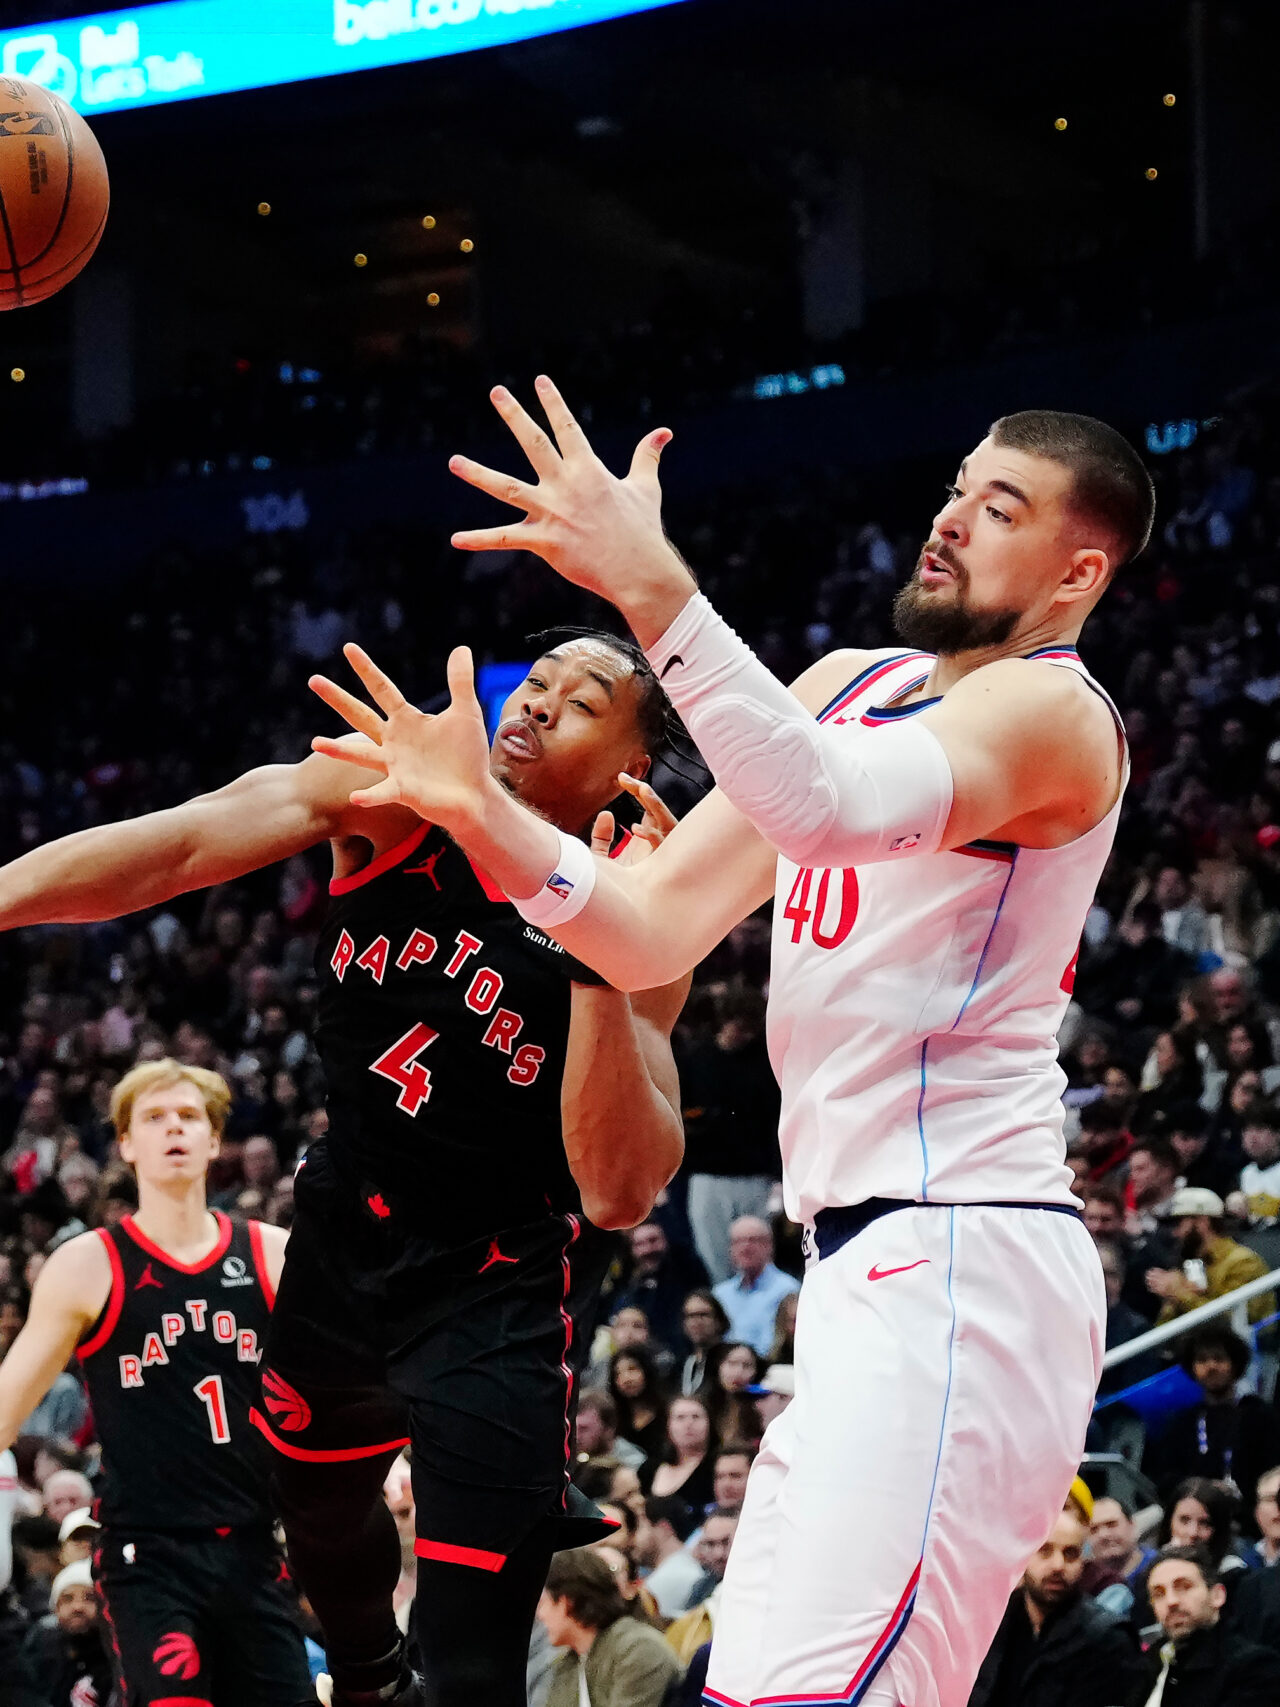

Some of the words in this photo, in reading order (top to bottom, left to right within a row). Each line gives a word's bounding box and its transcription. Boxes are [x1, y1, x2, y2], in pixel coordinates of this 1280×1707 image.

[523, 926, 547, 946] Sun
[783, 866, 860, 950] 40
[330, 927, 546, 1087] RAPTORS
[368, 1021, 440, 1118] 4
[118, 1299, 263, 1389] RAPTOR
[192, 1374, 231, 1445] 1
